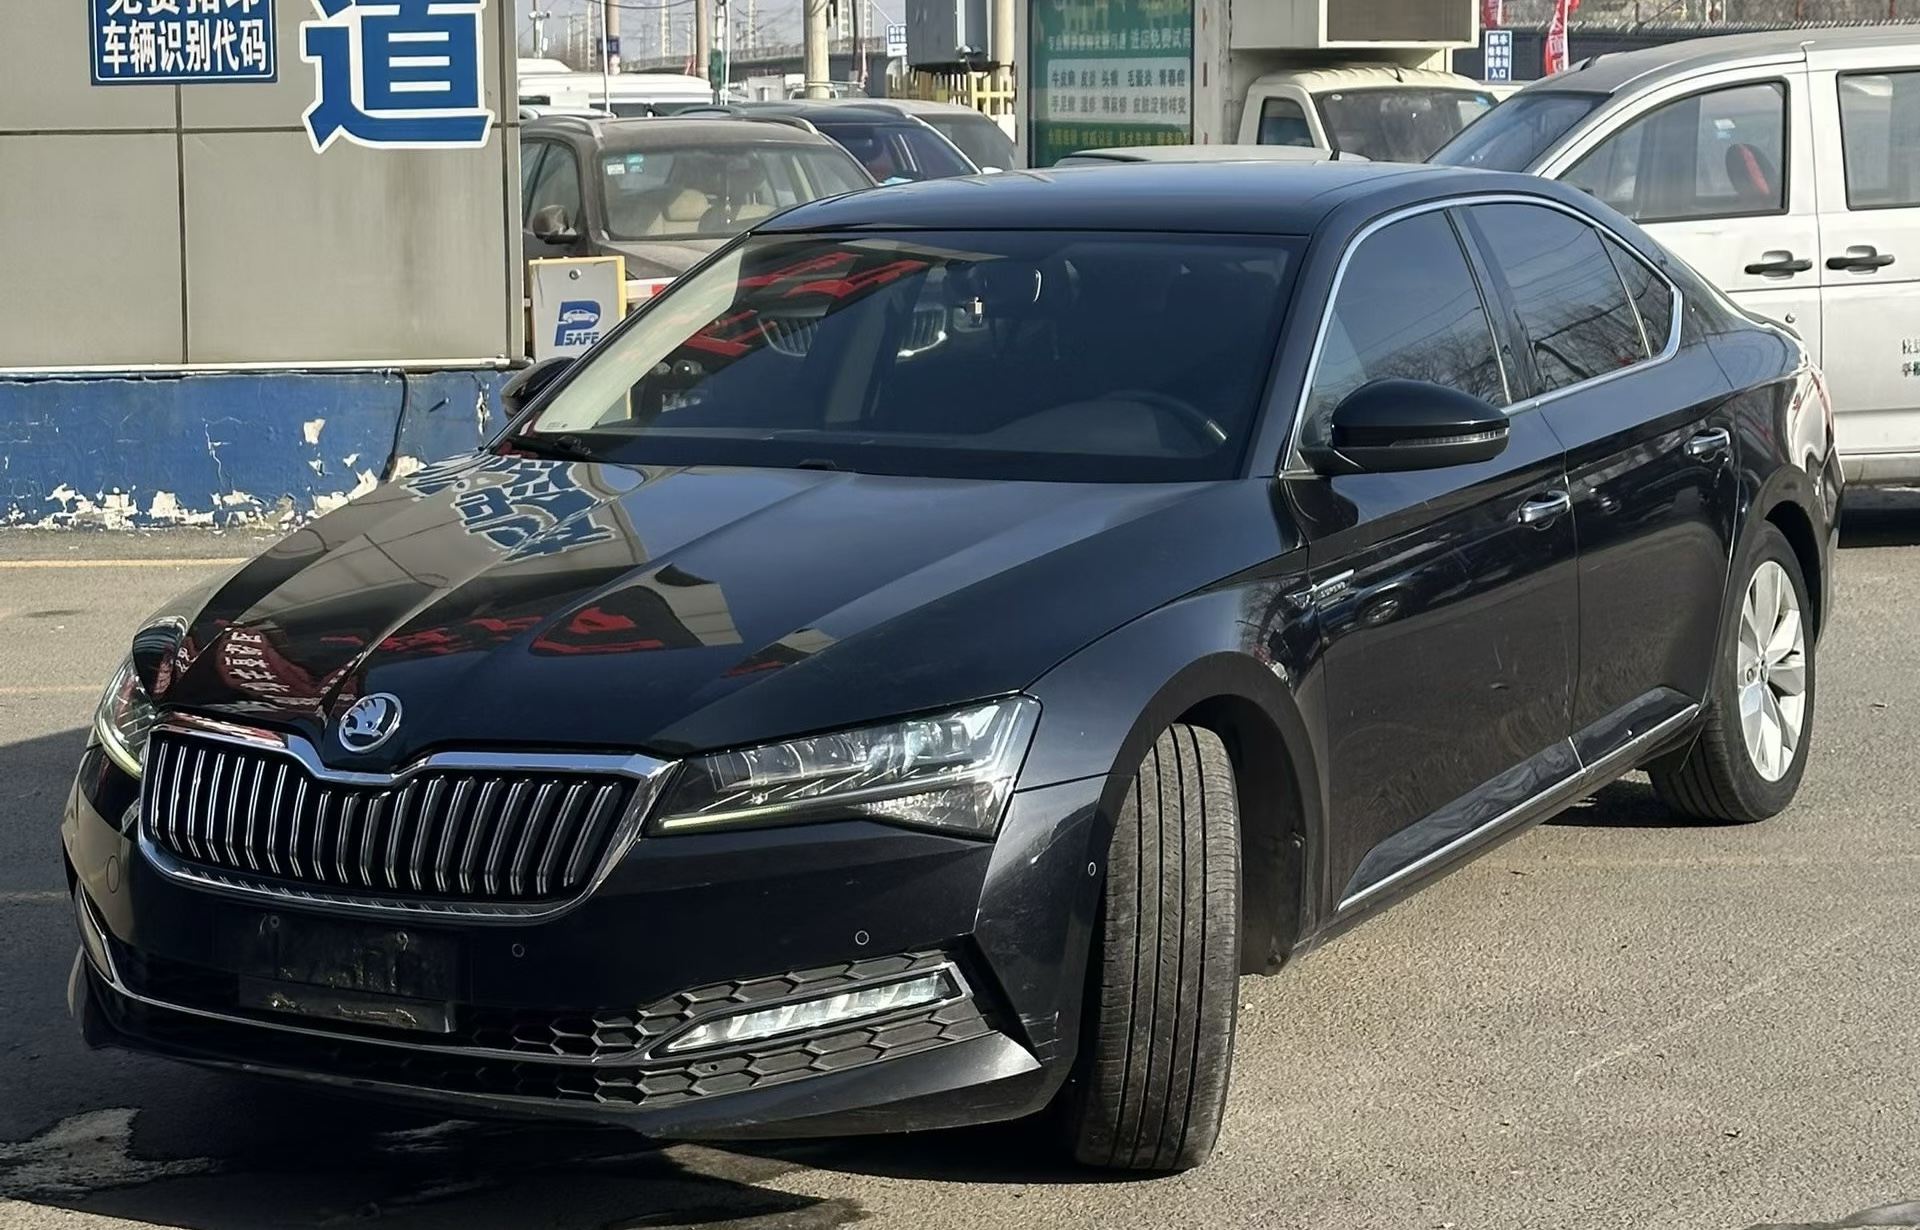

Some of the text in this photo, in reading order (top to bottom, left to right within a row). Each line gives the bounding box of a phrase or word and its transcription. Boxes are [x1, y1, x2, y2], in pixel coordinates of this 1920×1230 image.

[103, 19, 267, 74] 车辆识别代码
[302, 0, 492, 152] 道
[564, 332, 600, 346] SAFE
